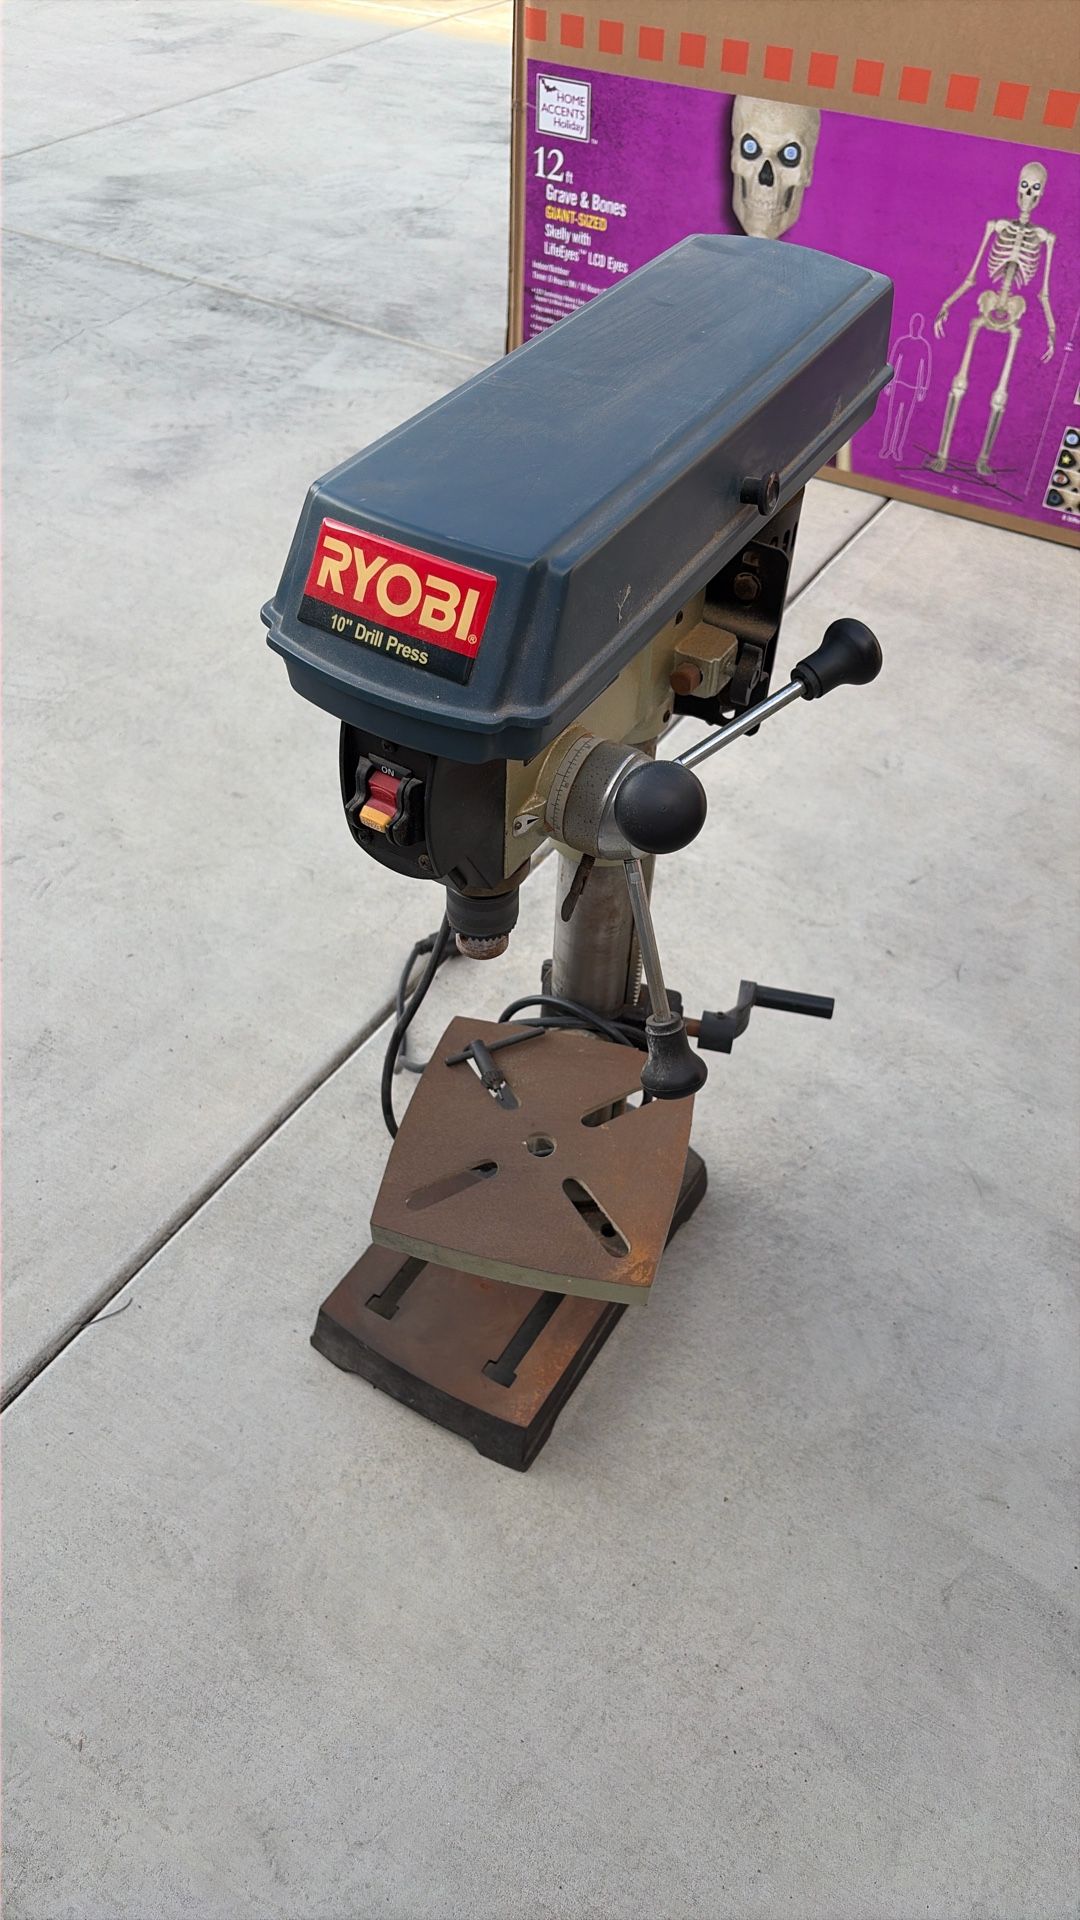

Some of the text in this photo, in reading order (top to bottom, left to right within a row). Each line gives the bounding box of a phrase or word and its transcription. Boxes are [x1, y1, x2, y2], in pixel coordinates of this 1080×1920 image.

[556, 92, 586, 107] HOME
[541, 103, 586, 121] ACCENTS
[553, 118, 585, 135] Holiday
[533, 146, 574, 185] 12 ft
[545, 183, 628, 218] Grave & Bones
[544, 204, 608, 232] GIANT-SIZED
[544, 223, 592, 247] Skelly with
[587, 251, 607, 268] LCD
[606, 256, 629, 274] Eyes
[331, 613, 429, 665] 10" Drill Press
[381, 765, 395, 777] ON
